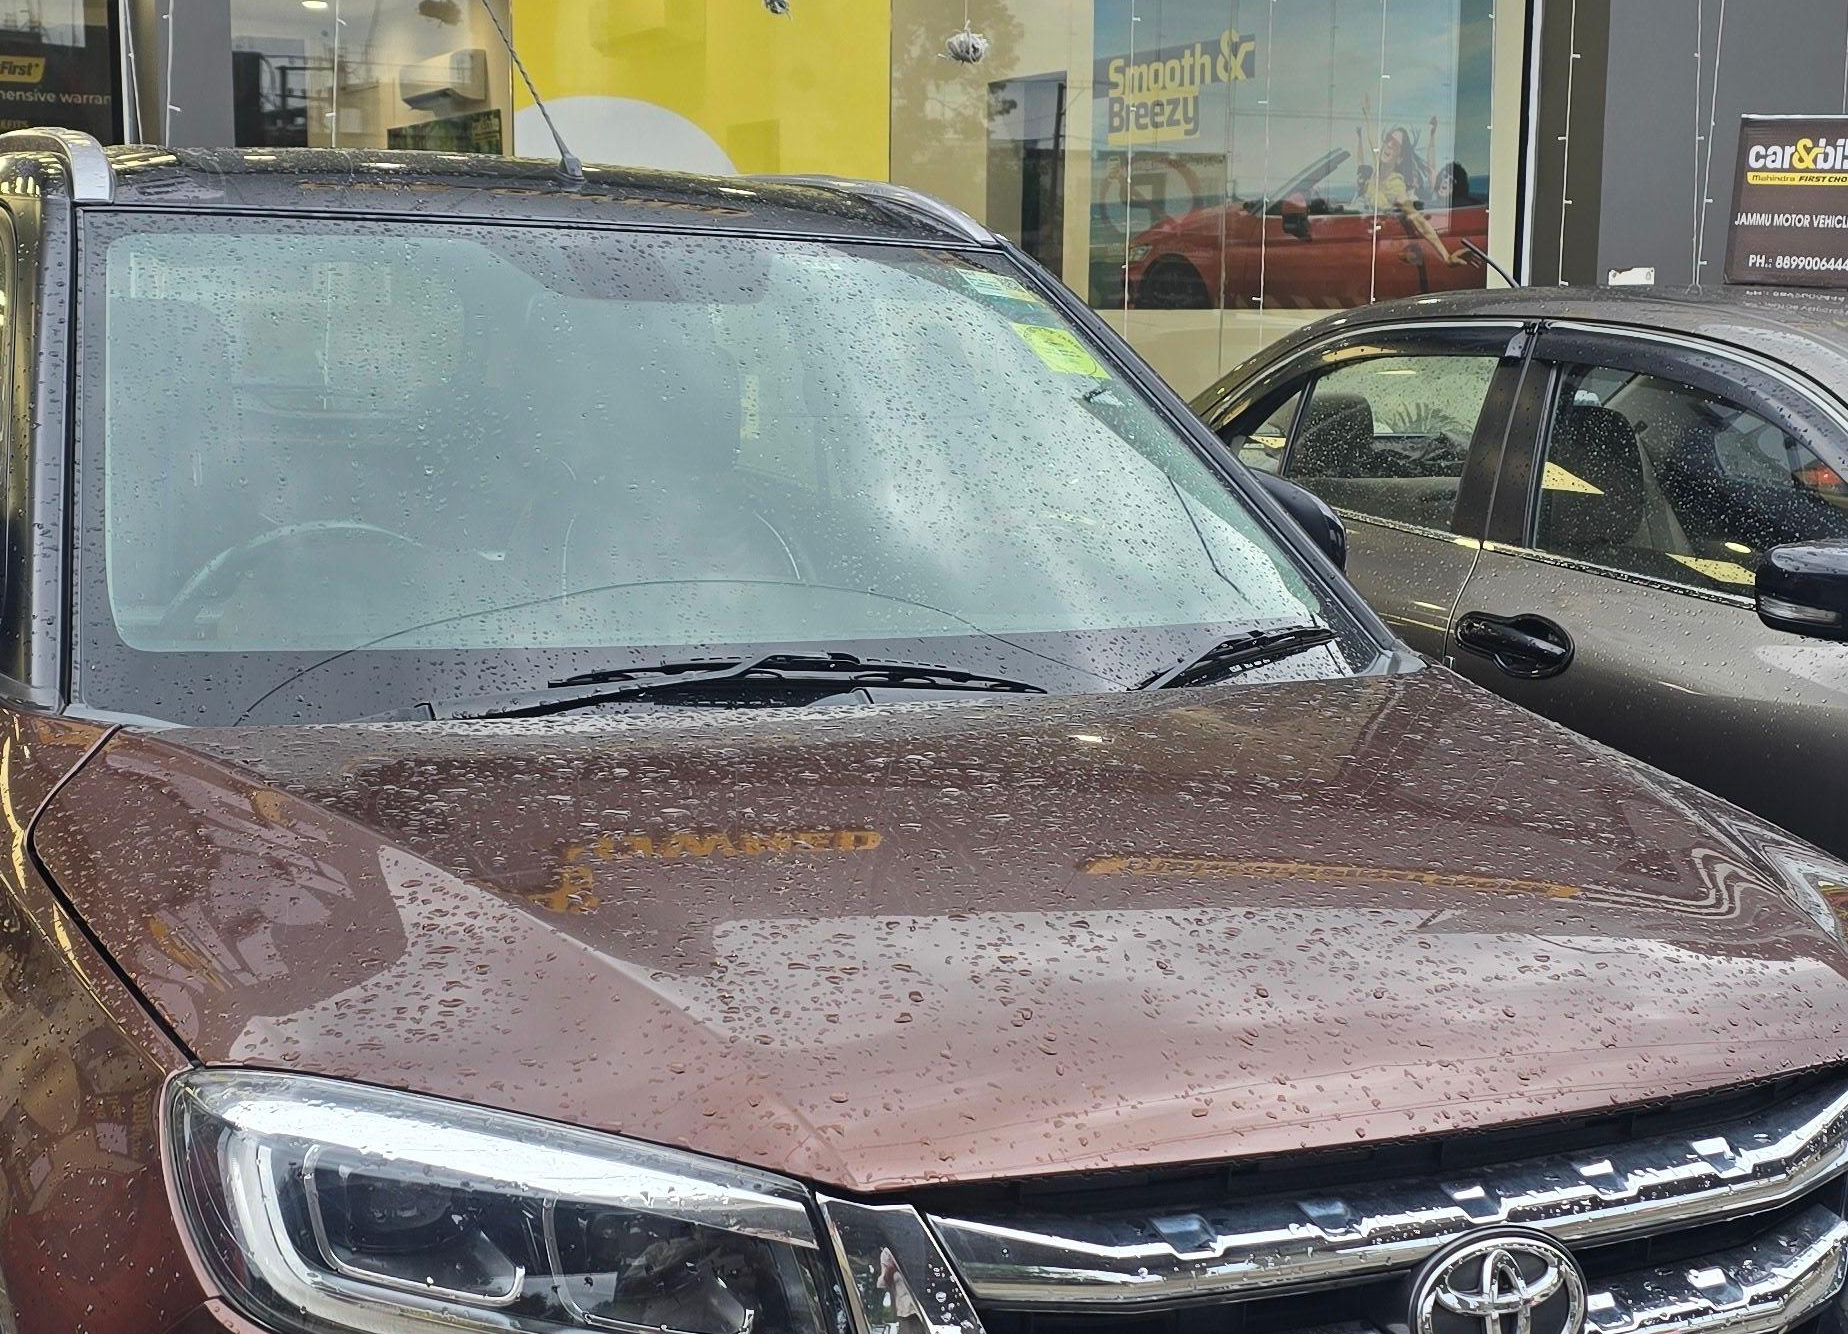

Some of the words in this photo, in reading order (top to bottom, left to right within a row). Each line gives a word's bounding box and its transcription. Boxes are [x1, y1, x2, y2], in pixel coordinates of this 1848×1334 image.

[1108, 43, 1211, 97] Smooth
[1108, 95, 1200, 137] Breezy
[1752, 175, 1796, 183] Mahindra
[1798, 175, 1826, 183] FIRST
[1735, 212, 1771, 227] JAMMU
[1773, 213, 1811, 228] MOTOR
[1813, 214, 1848, 229] VEHICL
